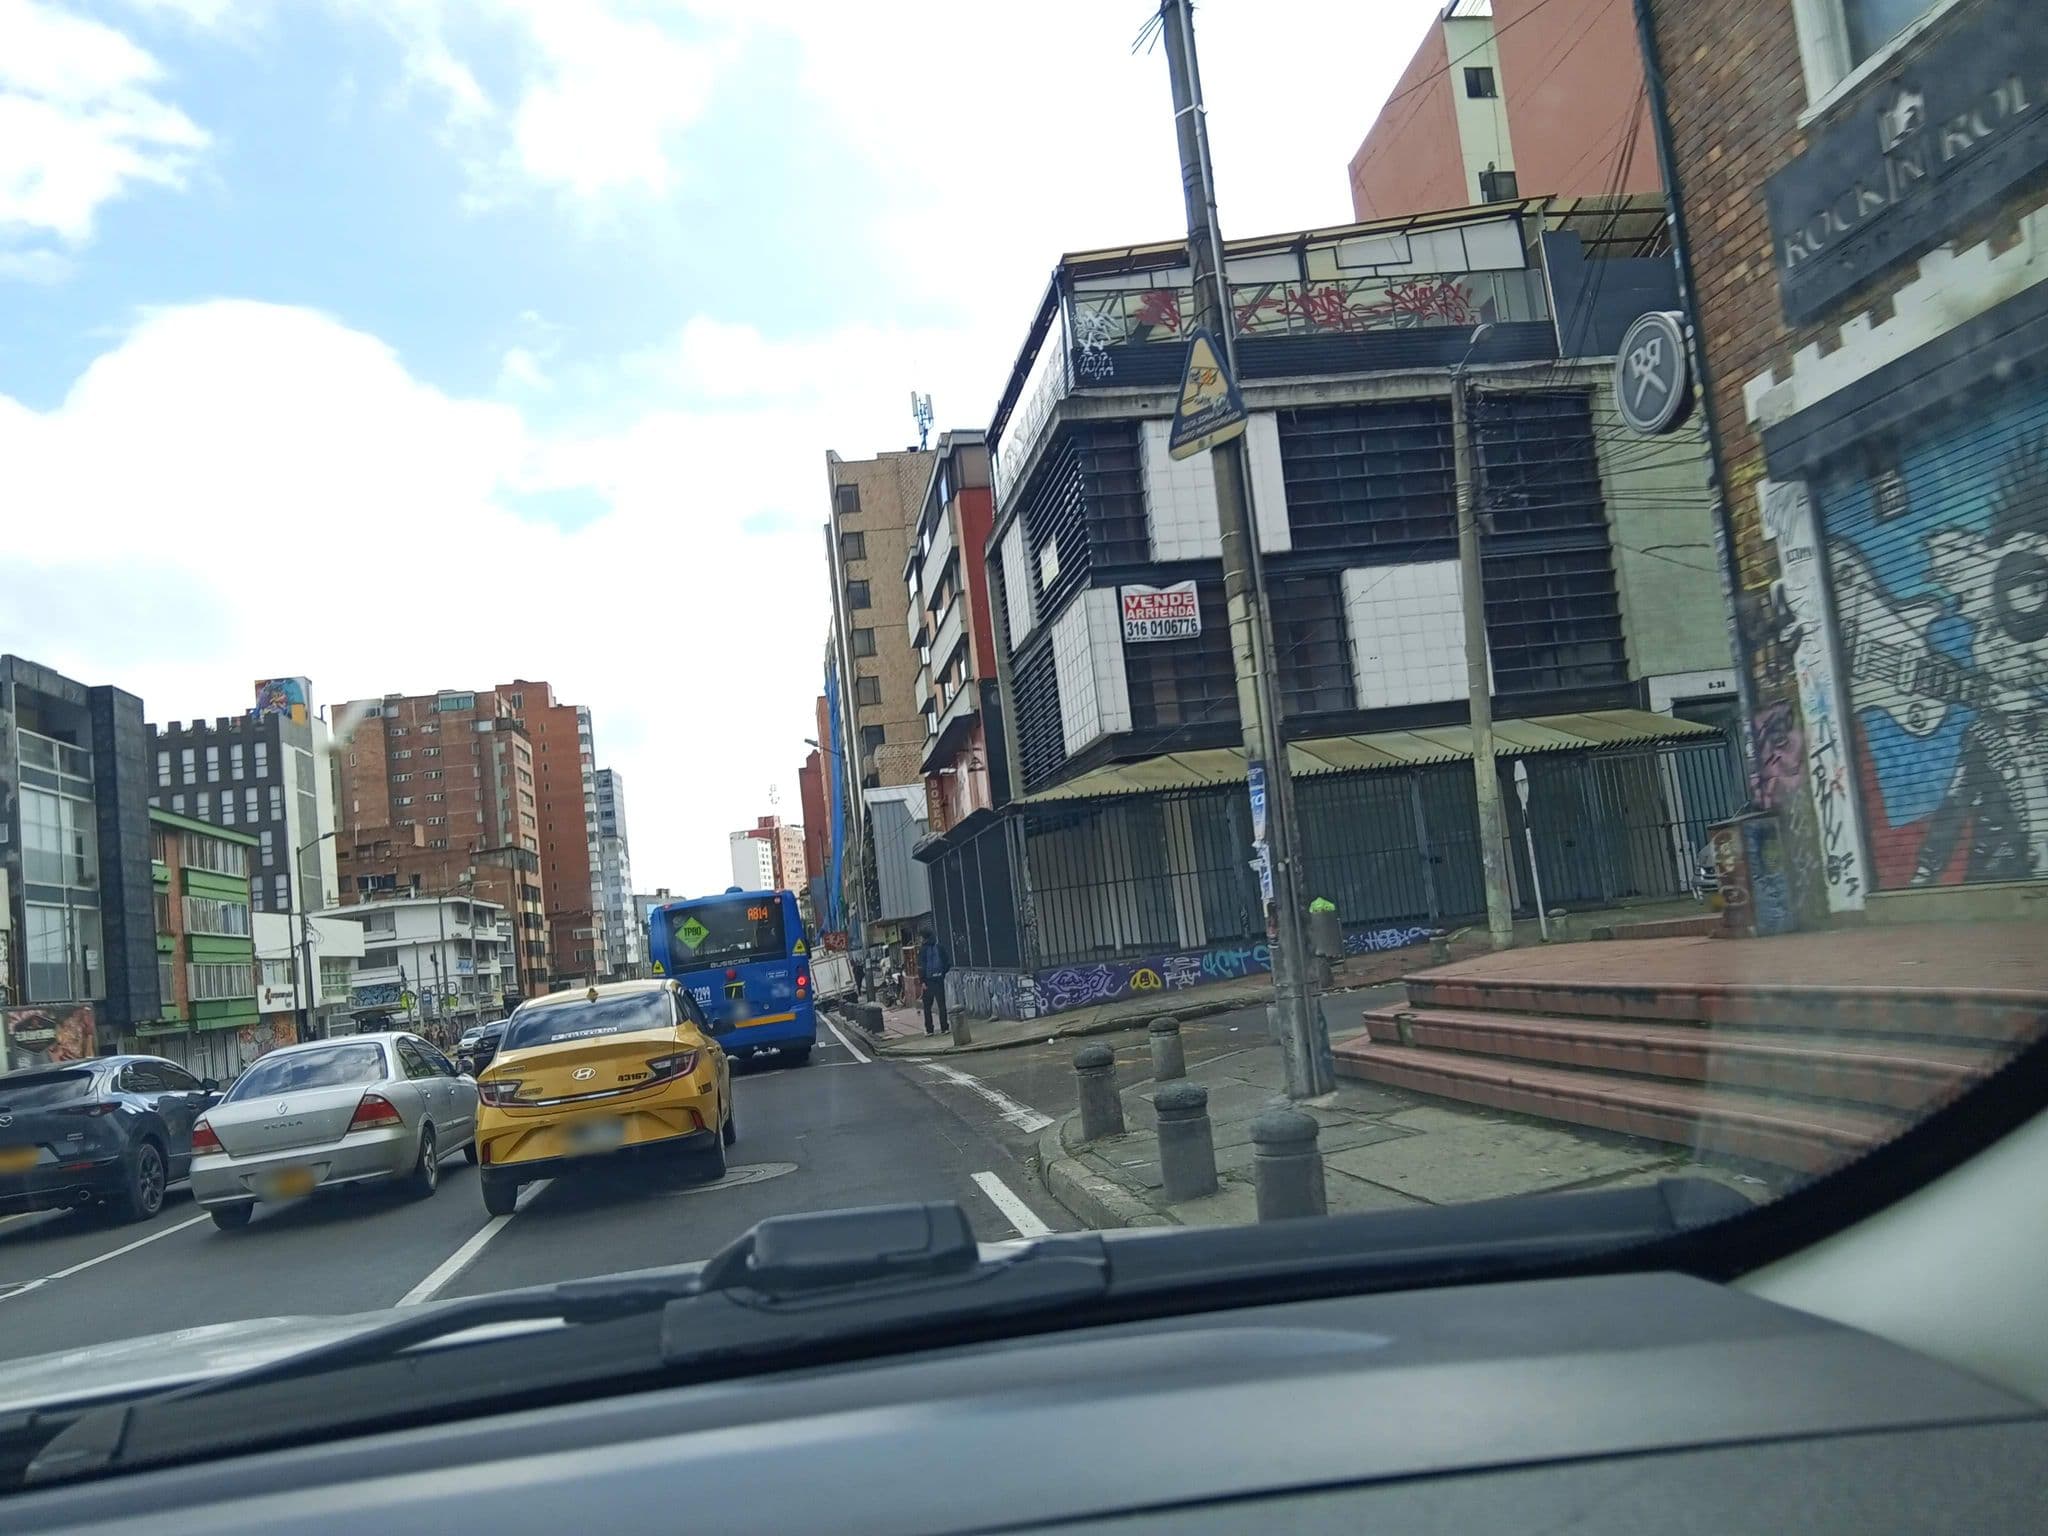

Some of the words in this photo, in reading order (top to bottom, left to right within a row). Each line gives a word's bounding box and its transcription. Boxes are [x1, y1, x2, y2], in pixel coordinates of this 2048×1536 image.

[1125, 593, 1195, 609] VENDE
[1126, 605, 1195, 620] ARRIENDA
[1126, 621, 1148, 637] 316
[1150, 618, 1199, 635] 0106776
